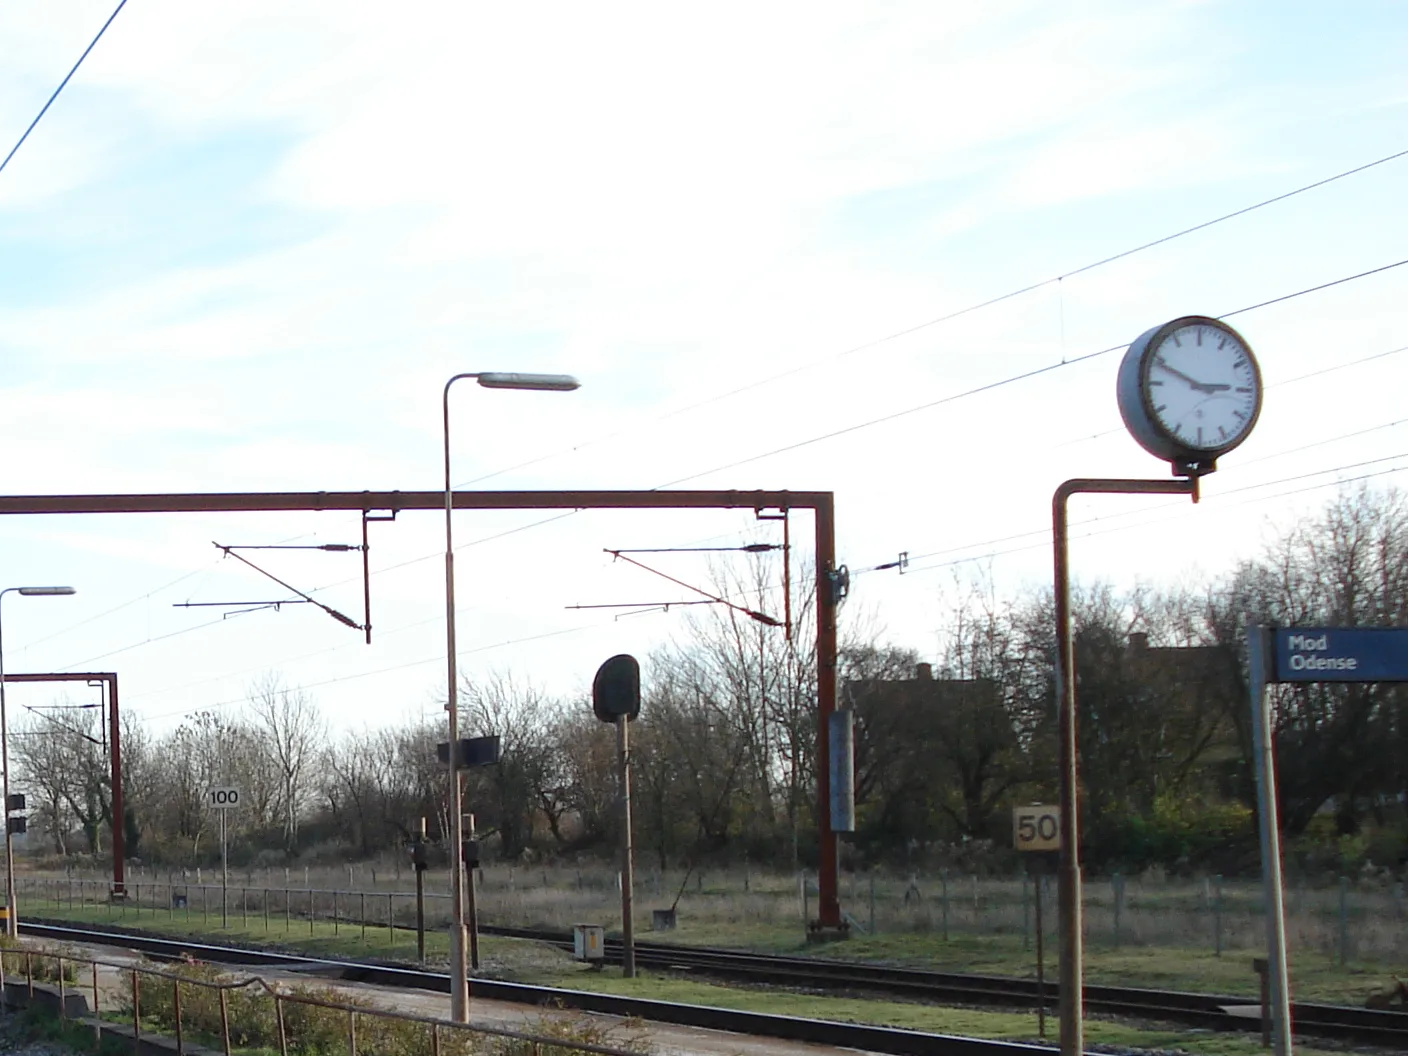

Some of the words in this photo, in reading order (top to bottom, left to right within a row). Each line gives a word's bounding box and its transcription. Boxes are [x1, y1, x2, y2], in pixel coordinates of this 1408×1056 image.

[1288, 635, 1327, 651] Mod
[1290, 654, 1357, 670] Odense
[211, 790, 238, 804] 100
[1019, 814, 1057, 841] 50
